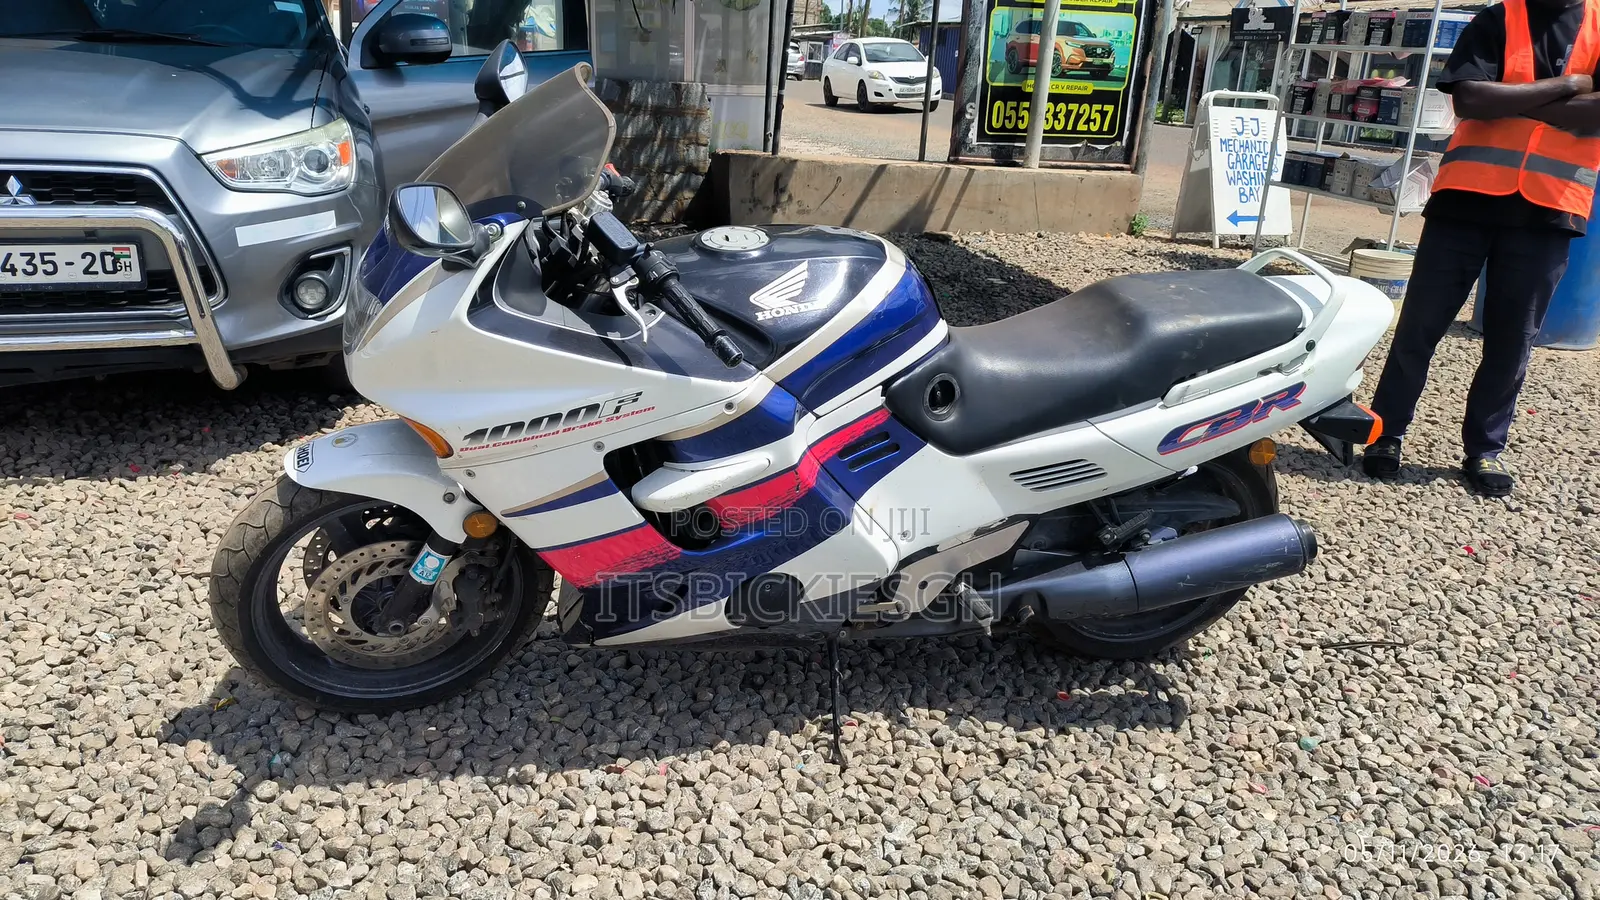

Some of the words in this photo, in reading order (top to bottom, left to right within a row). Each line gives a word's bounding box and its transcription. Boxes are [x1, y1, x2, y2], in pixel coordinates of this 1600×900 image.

[992, 101, 1114, 131] 055337257
[1219, 138, 1282, 157] MECHANICL
[1227, 153, 1268, 171] GARAGE
[1226, 169, 1273, 186] WASHIN
[1238, 186, 1261, 204] BAY
[755, 302, 826, 321] HOND
[462, 391, 643, 446] 1000F
[1157, 381, 1307, 456] CBR
[459, 443, 491, 452] Dual
[492, 430, 561, 448] Combined
[562, 419, 603, 434] Brake
[604, 406, 656, 423] System
